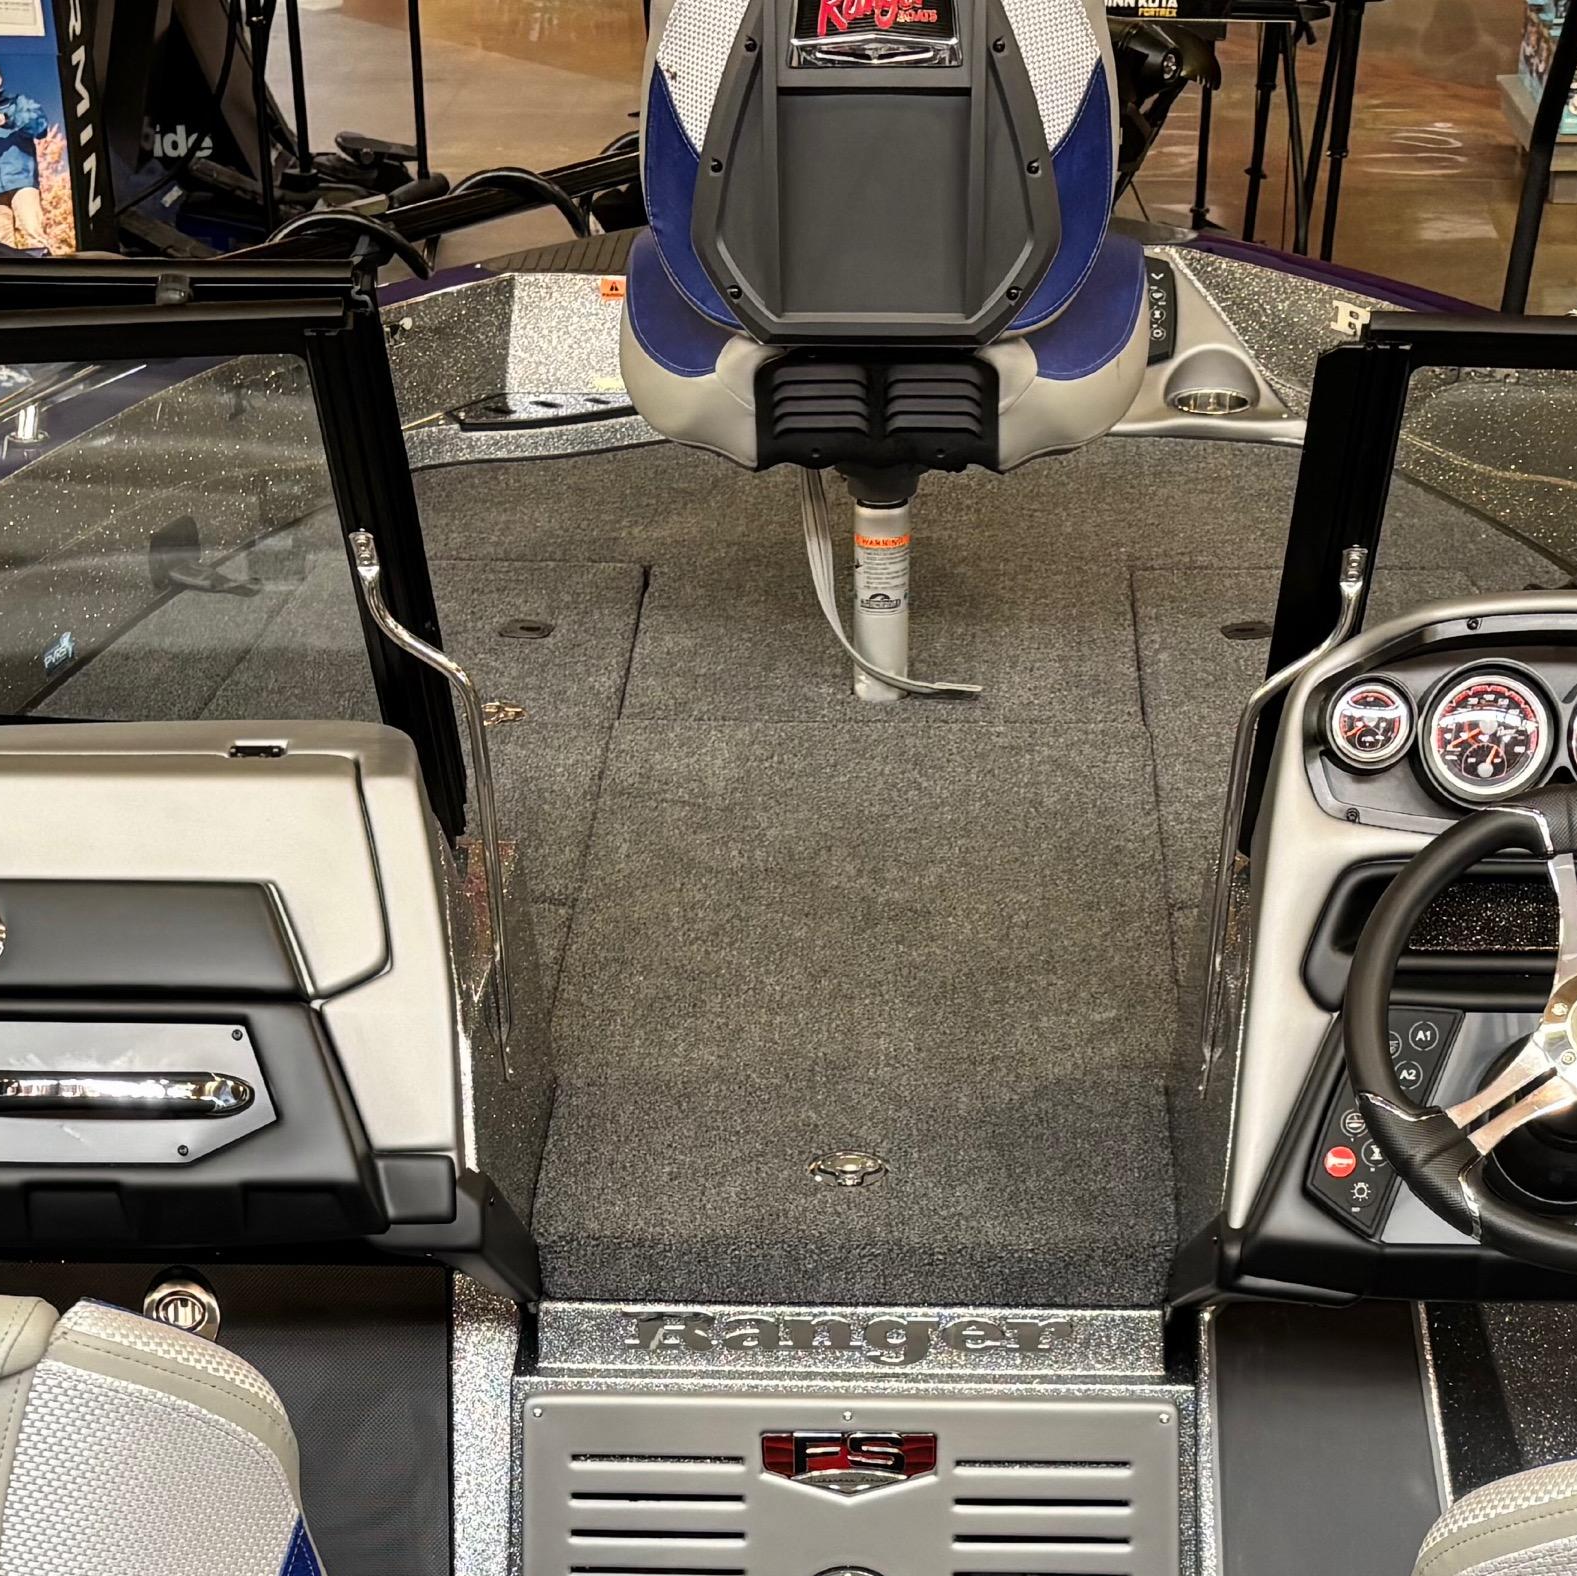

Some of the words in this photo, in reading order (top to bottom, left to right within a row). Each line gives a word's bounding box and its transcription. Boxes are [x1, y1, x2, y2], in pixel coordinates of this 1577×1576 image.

[1415, 1030, 1432, 1042] A1
[1399, 1069, 1417, 1081] A2
[624, 1309, 1072, 1366] Ranger
[792, 1431, 906, 1475] FS
